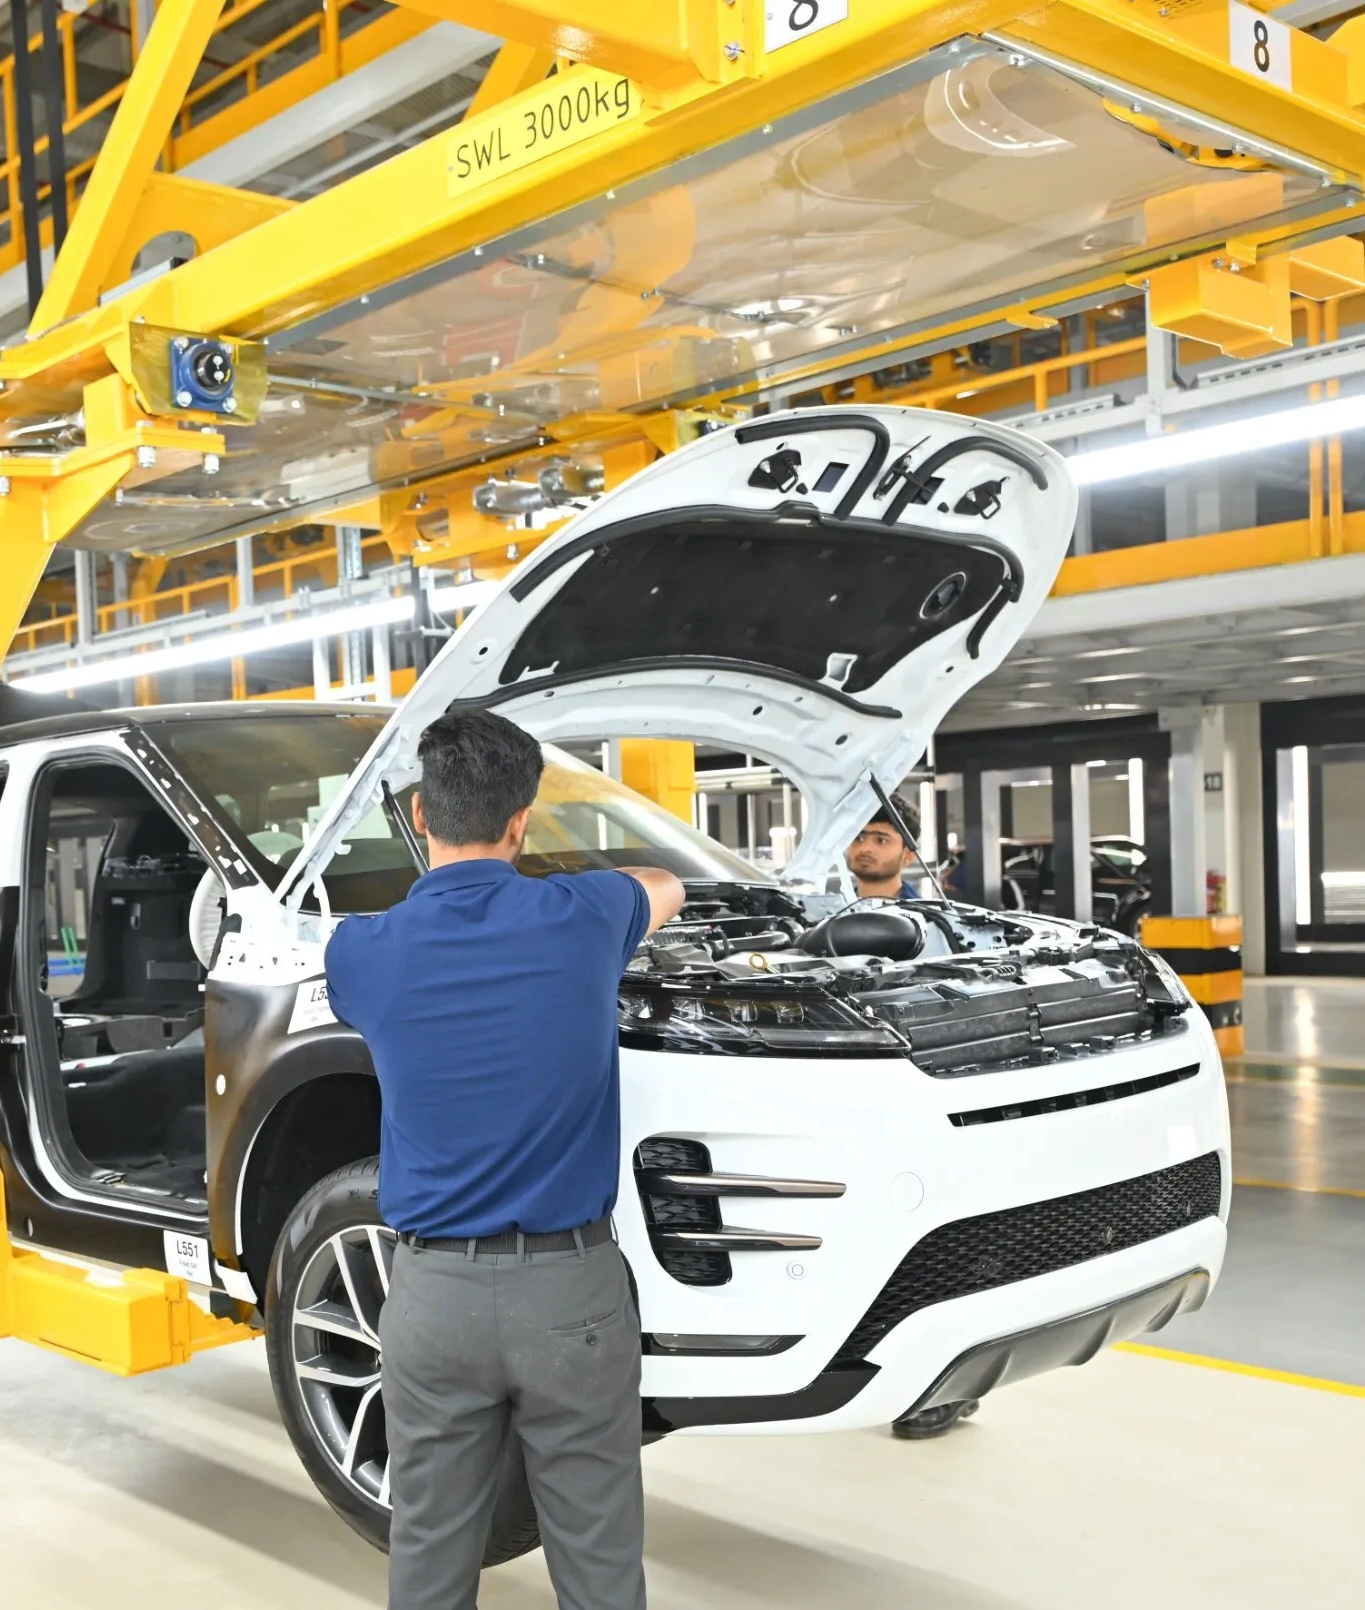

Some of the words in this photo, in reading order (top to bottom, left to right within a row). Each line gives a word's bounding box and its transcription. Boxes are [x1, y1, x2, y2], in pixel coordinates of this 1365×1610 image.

[1253, 20, 1270, 72] 8
[456, 127, 511, 178] SWL
[523, 78, 630, 149] 3000kg
[310, 986, 329, 1002] L5
[176, 1239, 199, 1258] L551
